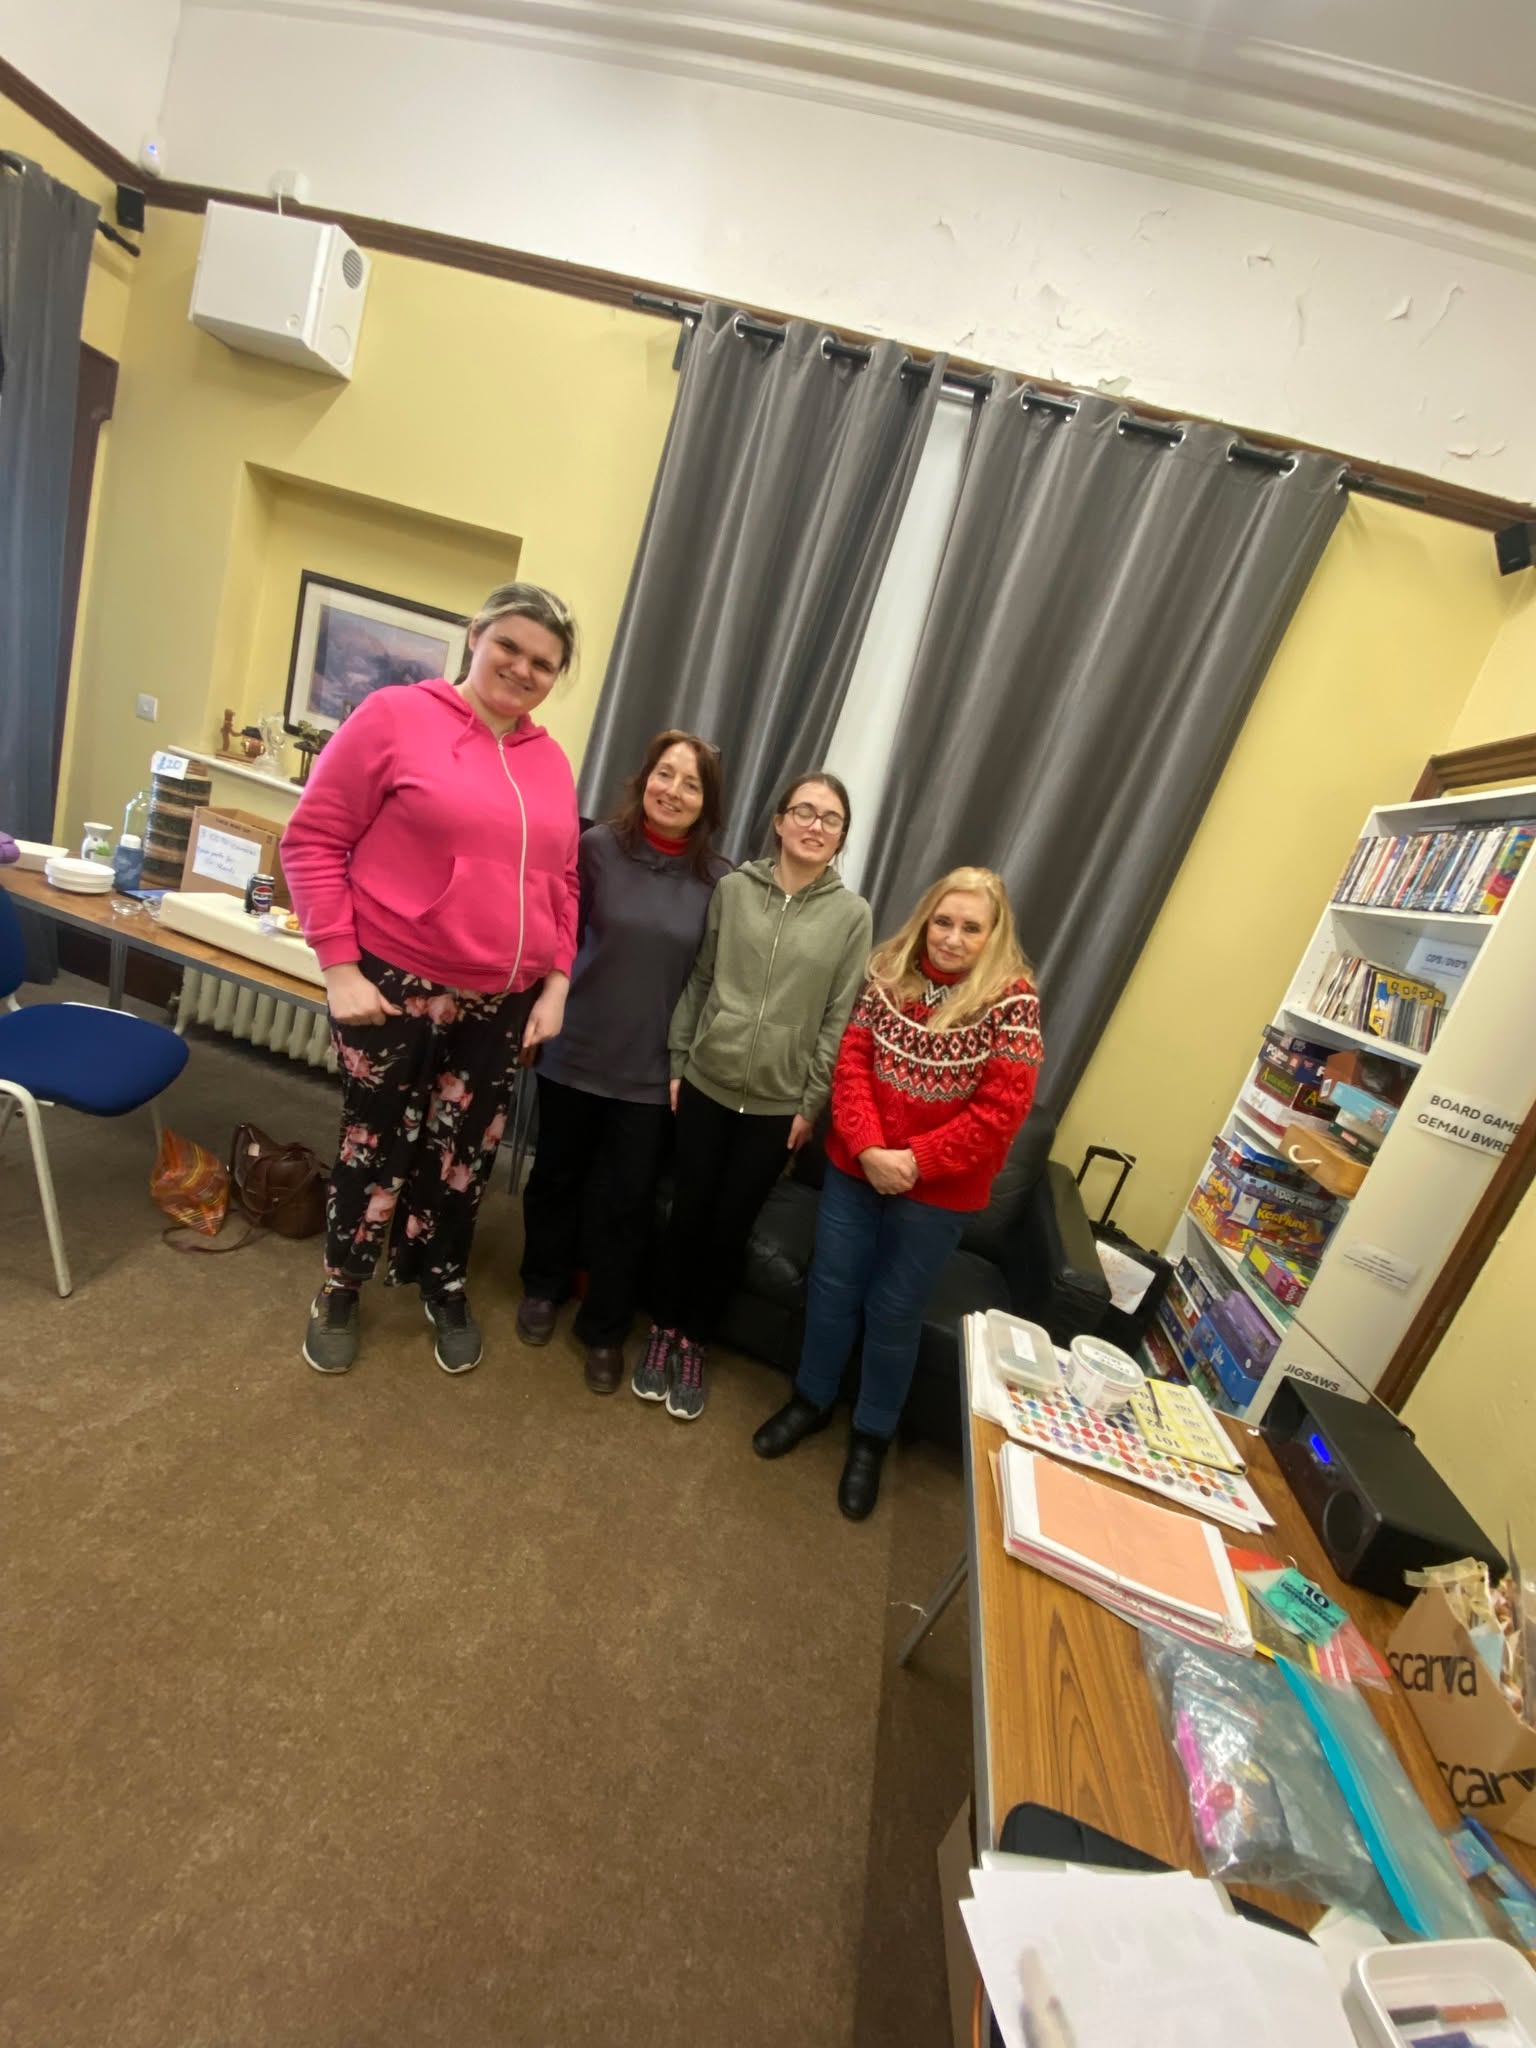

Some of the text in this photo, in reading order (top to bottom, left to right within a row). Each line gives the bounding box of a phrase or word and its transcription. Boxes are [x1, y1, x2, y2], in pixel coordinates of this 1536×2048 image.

[157, 756, 182, 771] £20
[1430, 1095, 1481, 1120] BOARD
[1417, 1113, 1470, 1139] GEMAU
[1284, 1363, 1341, 1392] JIGSAWS
[1302, 1583, 1330, 1609] 10
[1388, 1652, 1478, 1696] scarva
[1437, 1760, 1536, 1809] carv
